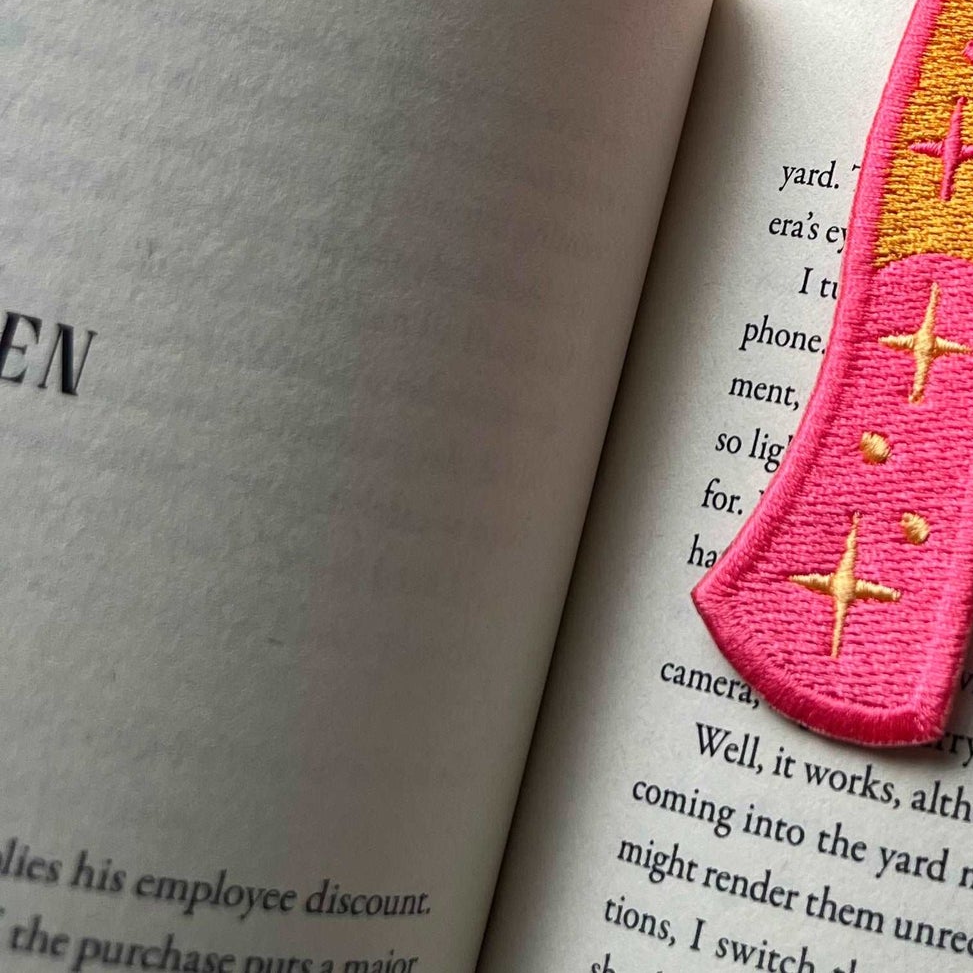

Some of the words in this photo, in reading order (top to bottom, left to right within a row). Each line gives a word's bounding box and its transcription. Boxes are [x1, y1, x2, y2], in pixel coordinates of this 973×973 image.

[778, 160, 840, 191] yard.
[768, 211, 820, 241] era's
[798, 267, 814, 295] I
[728, 377, 800, 412] ment,
[715, 433, 741, 454] so
[749, 427, 793, 473] lig
[701, 478, 742, 515] for.
[661, 663, 759, 709] camera,
[696, 722, 763, 774] Well,
[773, 747, 796, 778] it
[805, 763, 900, 809] works,
[633, 782, 736, 838] coming
[743, 804, 804, 846] into
[818, 823, 867, 862] the
[876, 847, 949, 882] yard
[71, 849, 126, 894] his
[135, 869, 298, 922] employee
[306, 879, 432, 916] discount.
[618, 840, 698, 883] might
[703, 868, 799, 910] render
[806, 886, 883, 933] them
[9, 915, 70, 957] the
[604, 895, 676, 947] tions,
[690, 918, 705, 951] I
